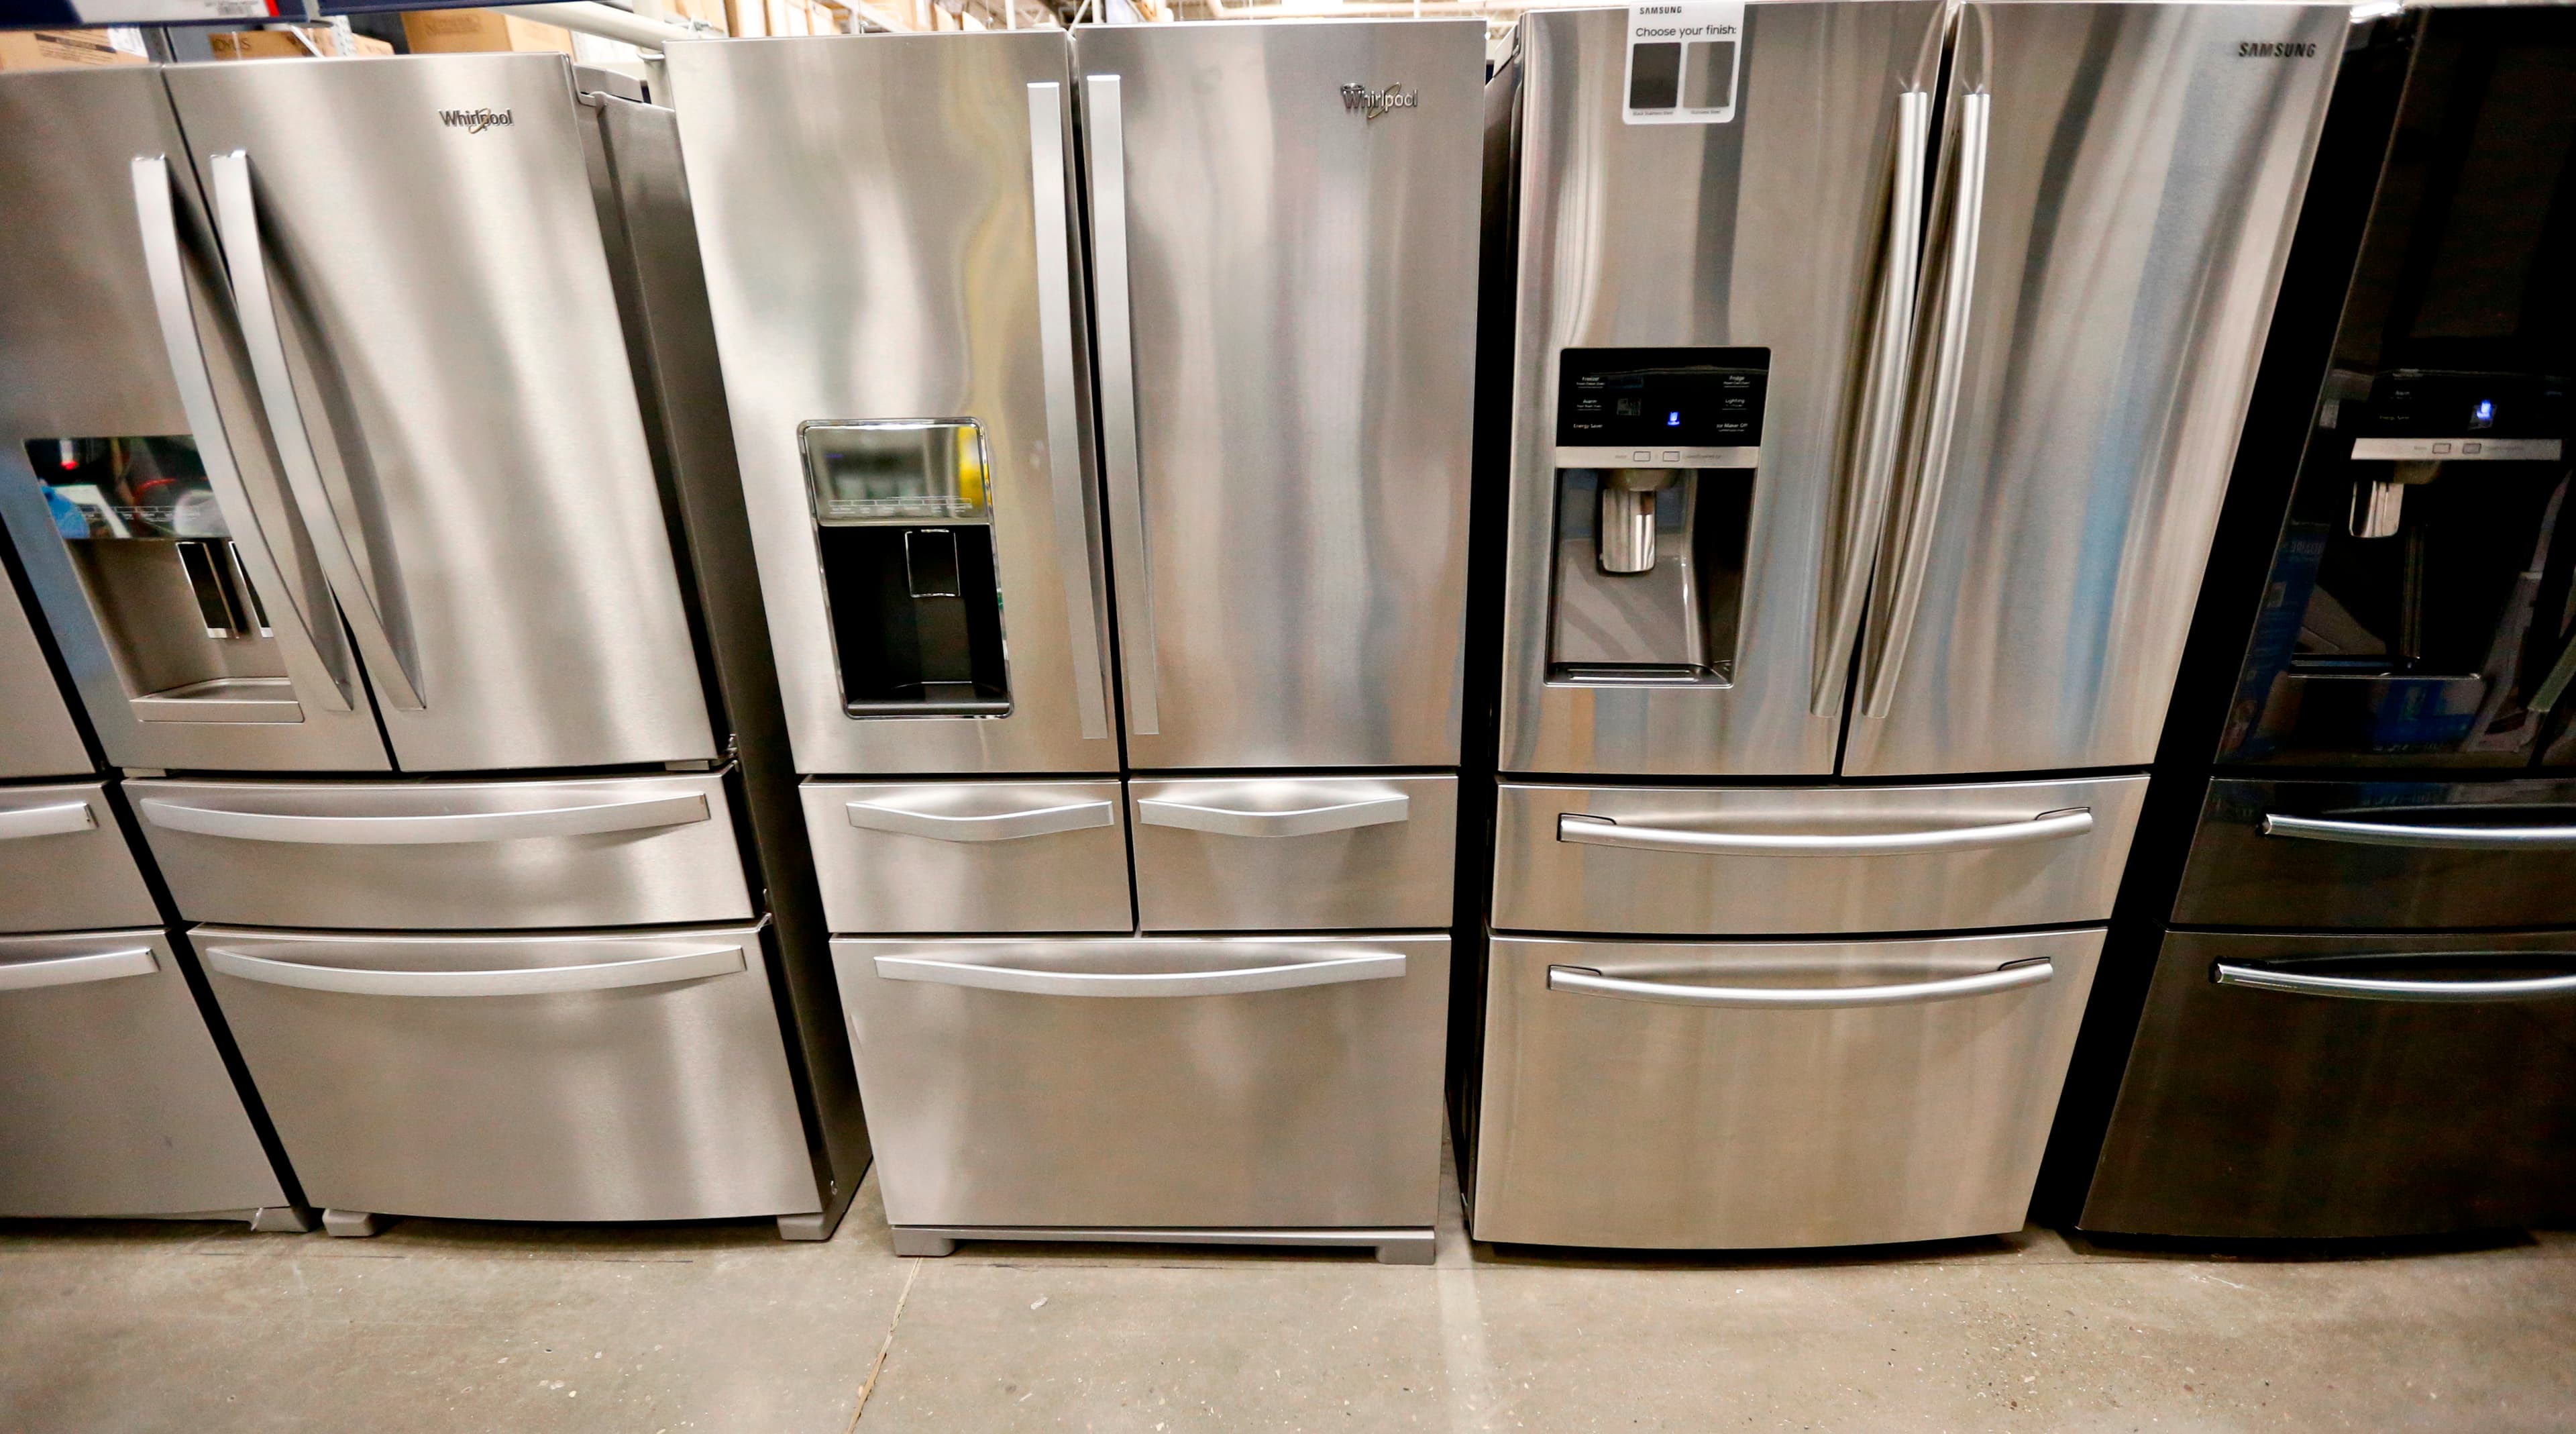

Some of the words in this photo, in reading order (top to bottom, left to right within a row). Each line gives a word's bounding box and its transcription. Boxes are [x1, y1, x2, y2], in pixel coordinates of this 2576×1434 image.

[1639, 5, 1682, 15] SAMSUNG
[1635, 27, 1676, 37] Choose
[1679, 26, 1704, 38] your
[1706, 24, 1737, 35] finish:
[2239, 42, 2316, 58] SAMSUNG
[1341, 83, 1418, 117] Whirlpool
[438, 108, 514, 133] Whirlpool
